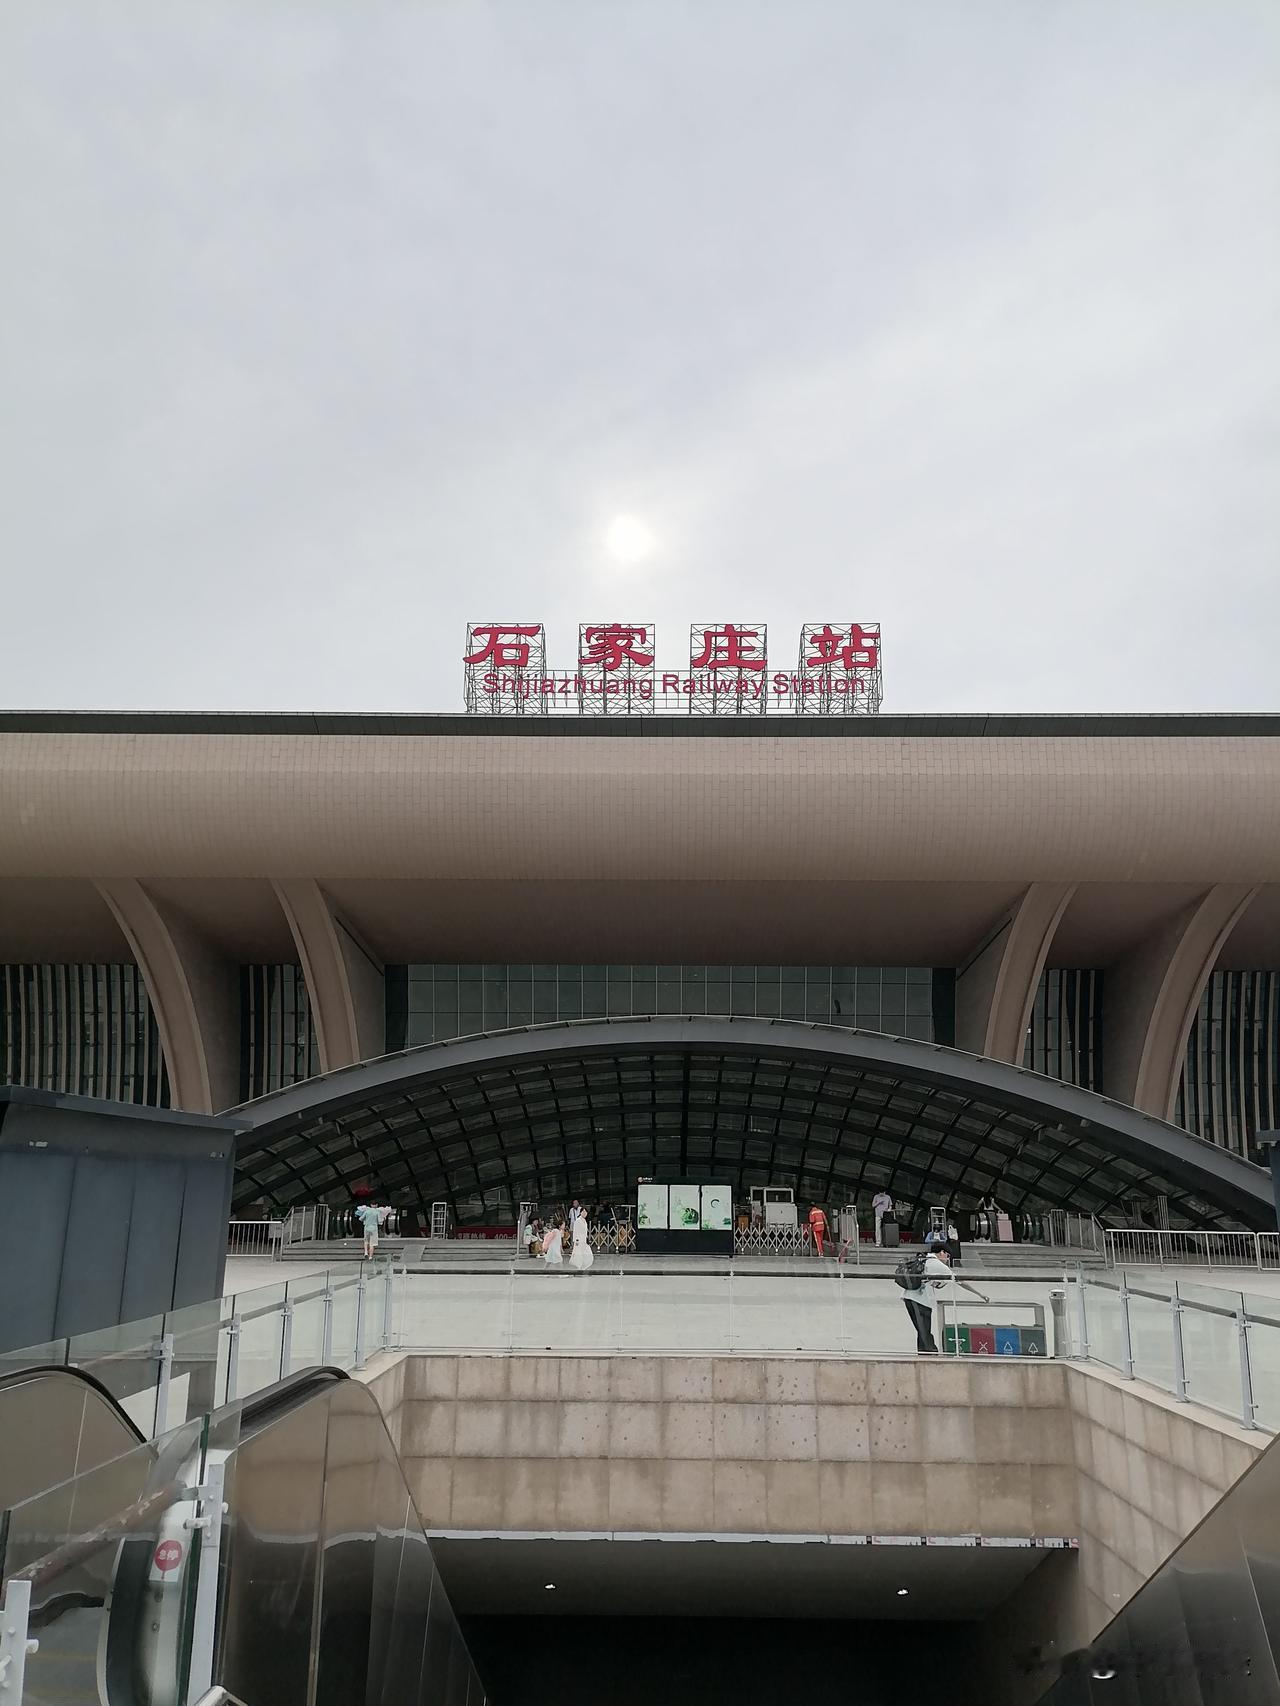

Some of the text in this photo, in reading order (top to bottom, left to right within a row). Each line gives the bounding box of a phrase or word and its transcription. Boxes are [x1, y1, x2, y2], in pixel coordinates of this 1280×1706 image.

[463, 623, 881, 671] 石家庄站
[483, 673, 865, 698] Shijiazhuang Railway Station
